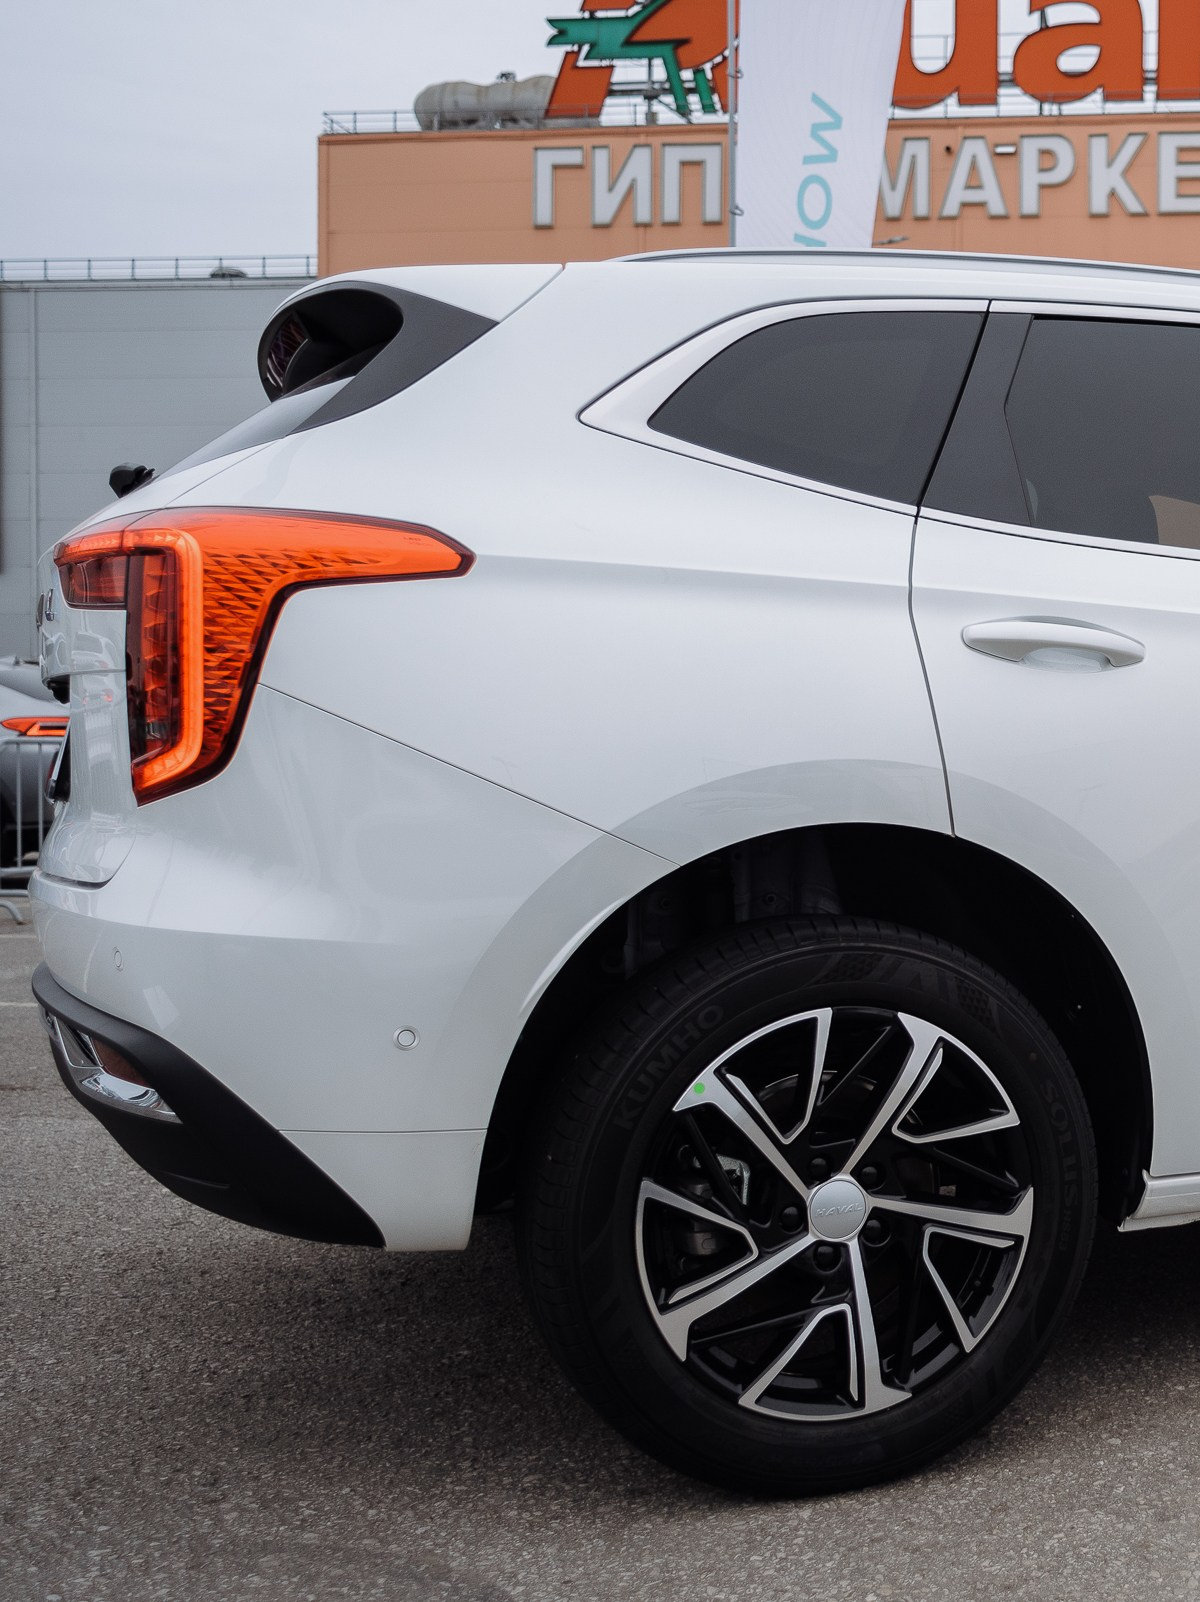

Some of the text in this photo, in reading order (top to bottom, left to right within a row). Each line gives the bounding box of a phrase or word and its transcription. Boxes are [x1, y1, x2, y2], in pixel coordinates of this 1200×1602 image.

[612, 1004, 724, 1130] KUMHO
[1039, 1077, 1080, 1207] SOLUS
[814, 1203, 864, 1217] HAVAL
